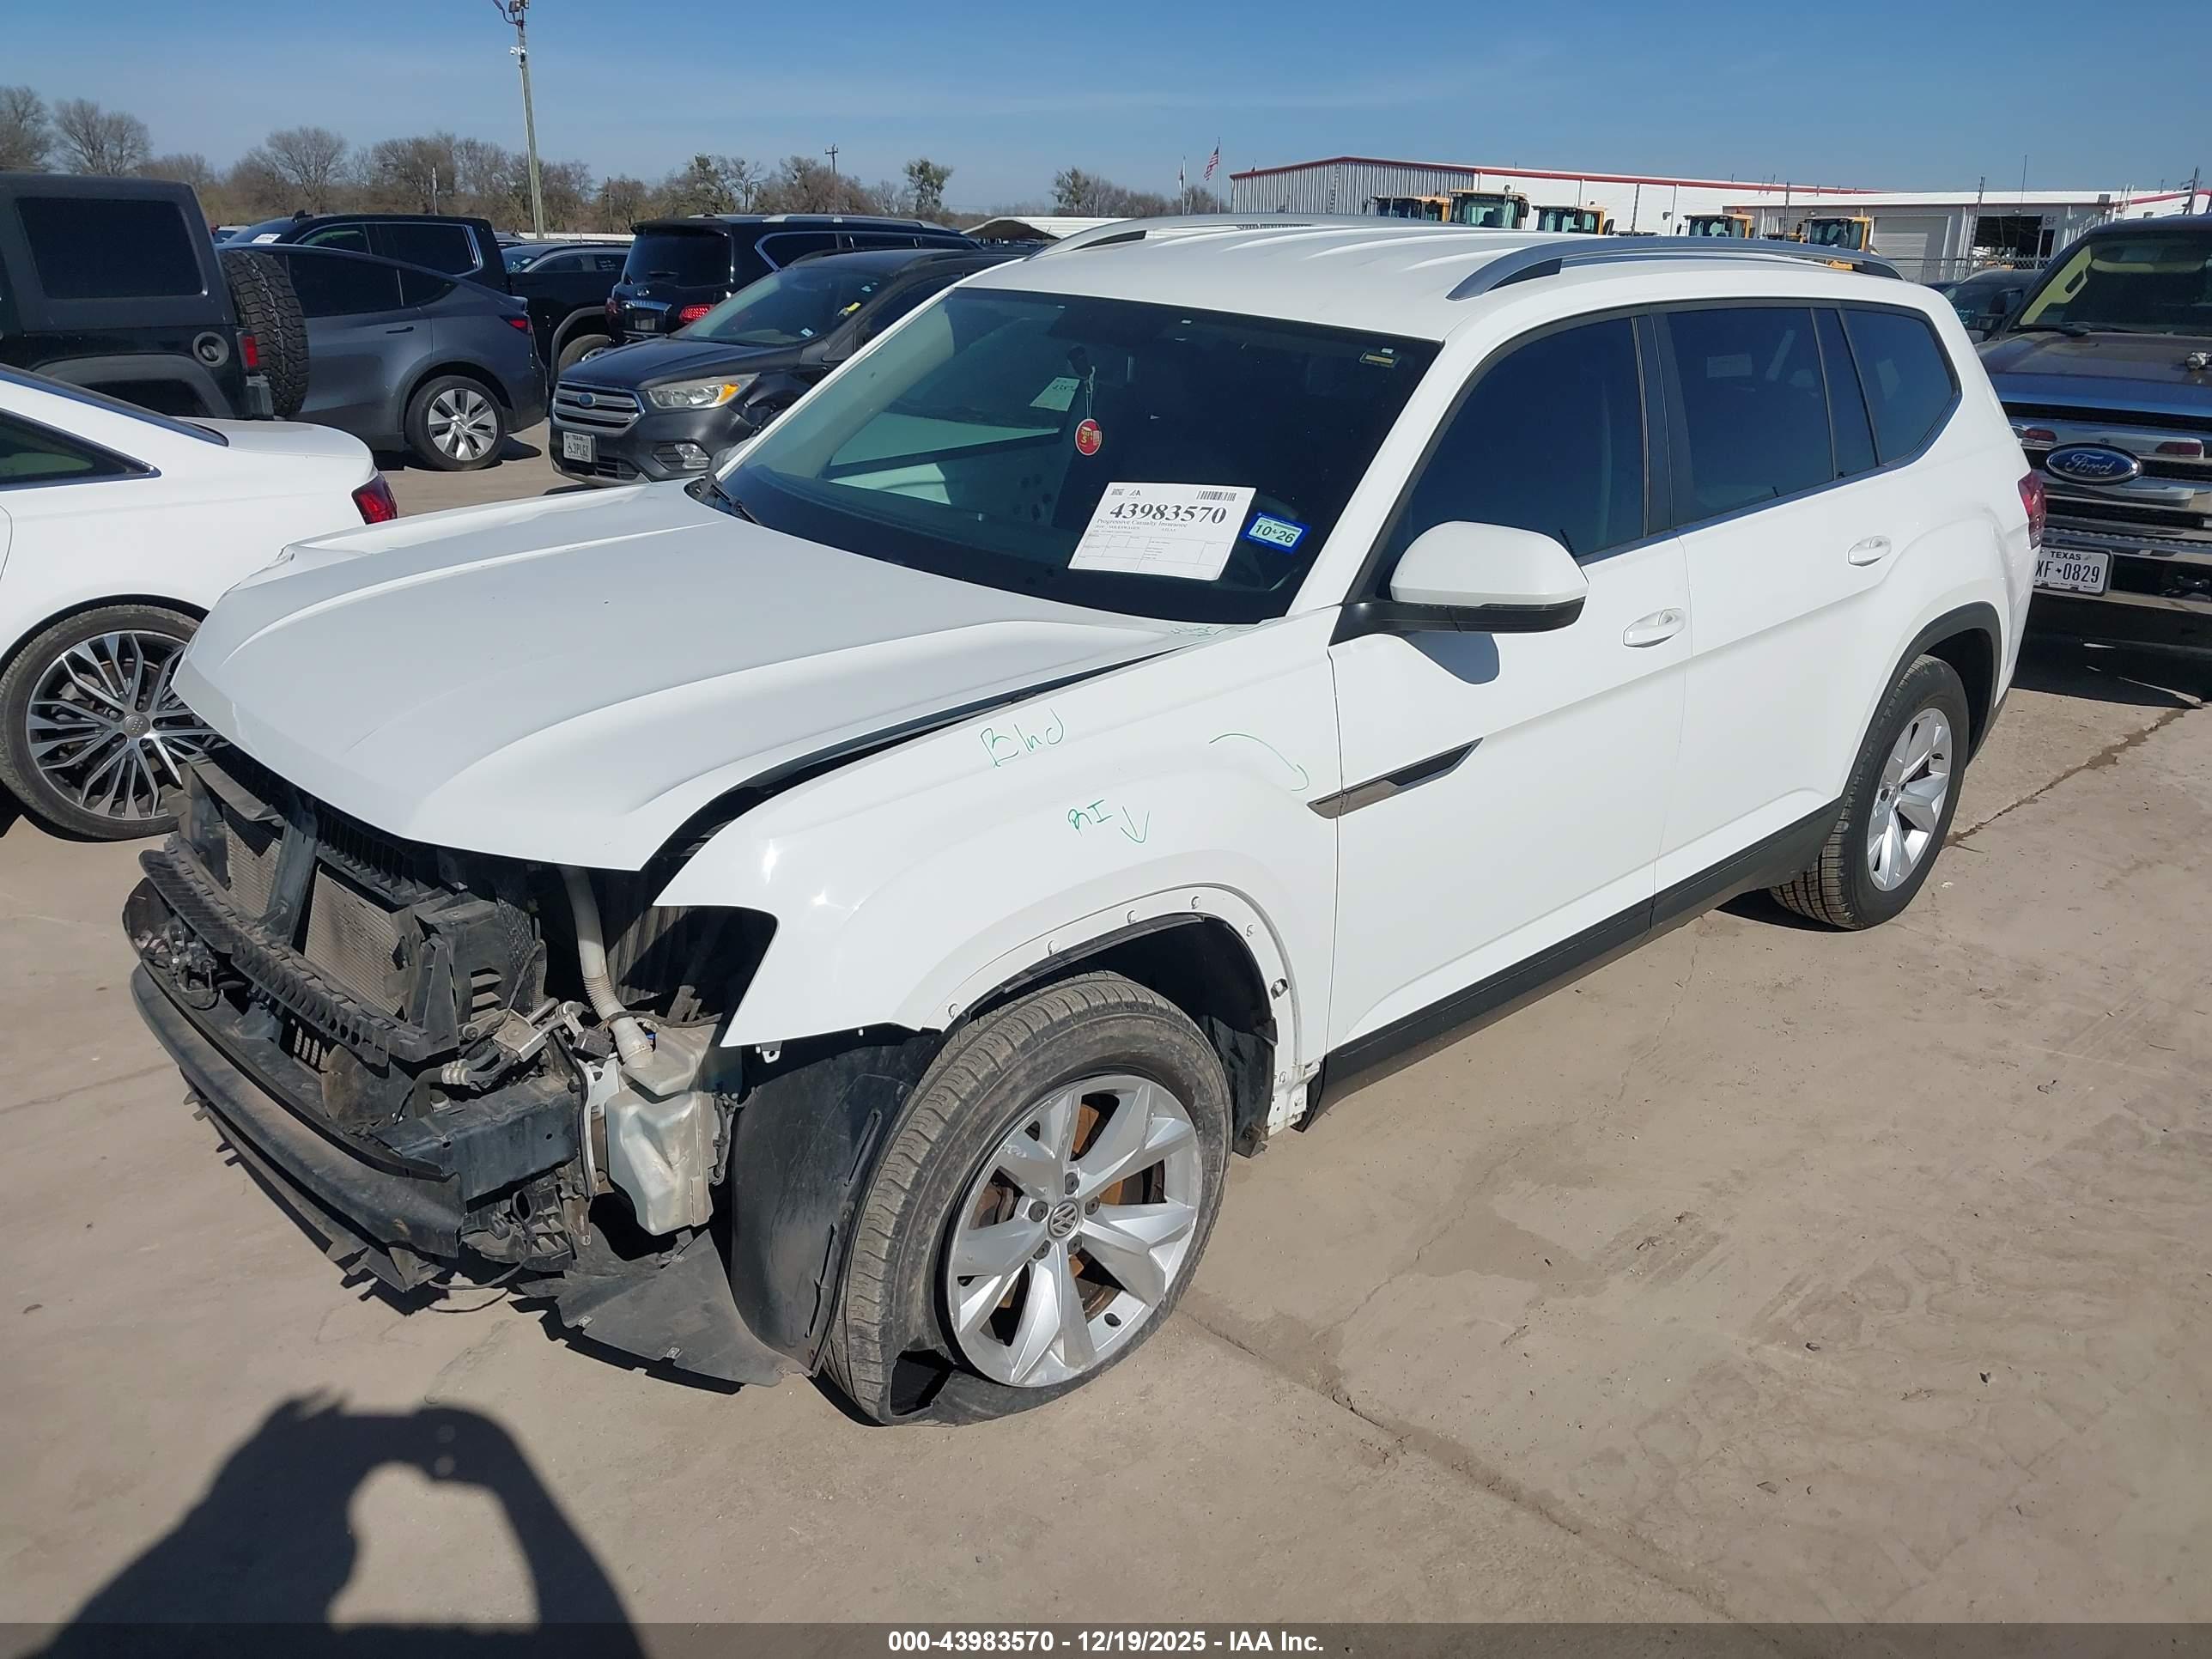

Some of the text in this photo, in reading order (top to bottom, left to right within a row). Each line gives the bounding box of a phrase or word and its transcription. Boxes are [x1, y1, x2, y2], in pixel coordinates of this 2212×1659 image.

[2064, 453, 2115, 475] Ford
[1109, 502, 1227, 525] 43983570
[2050, 550, 2081, 561] TEXAS
